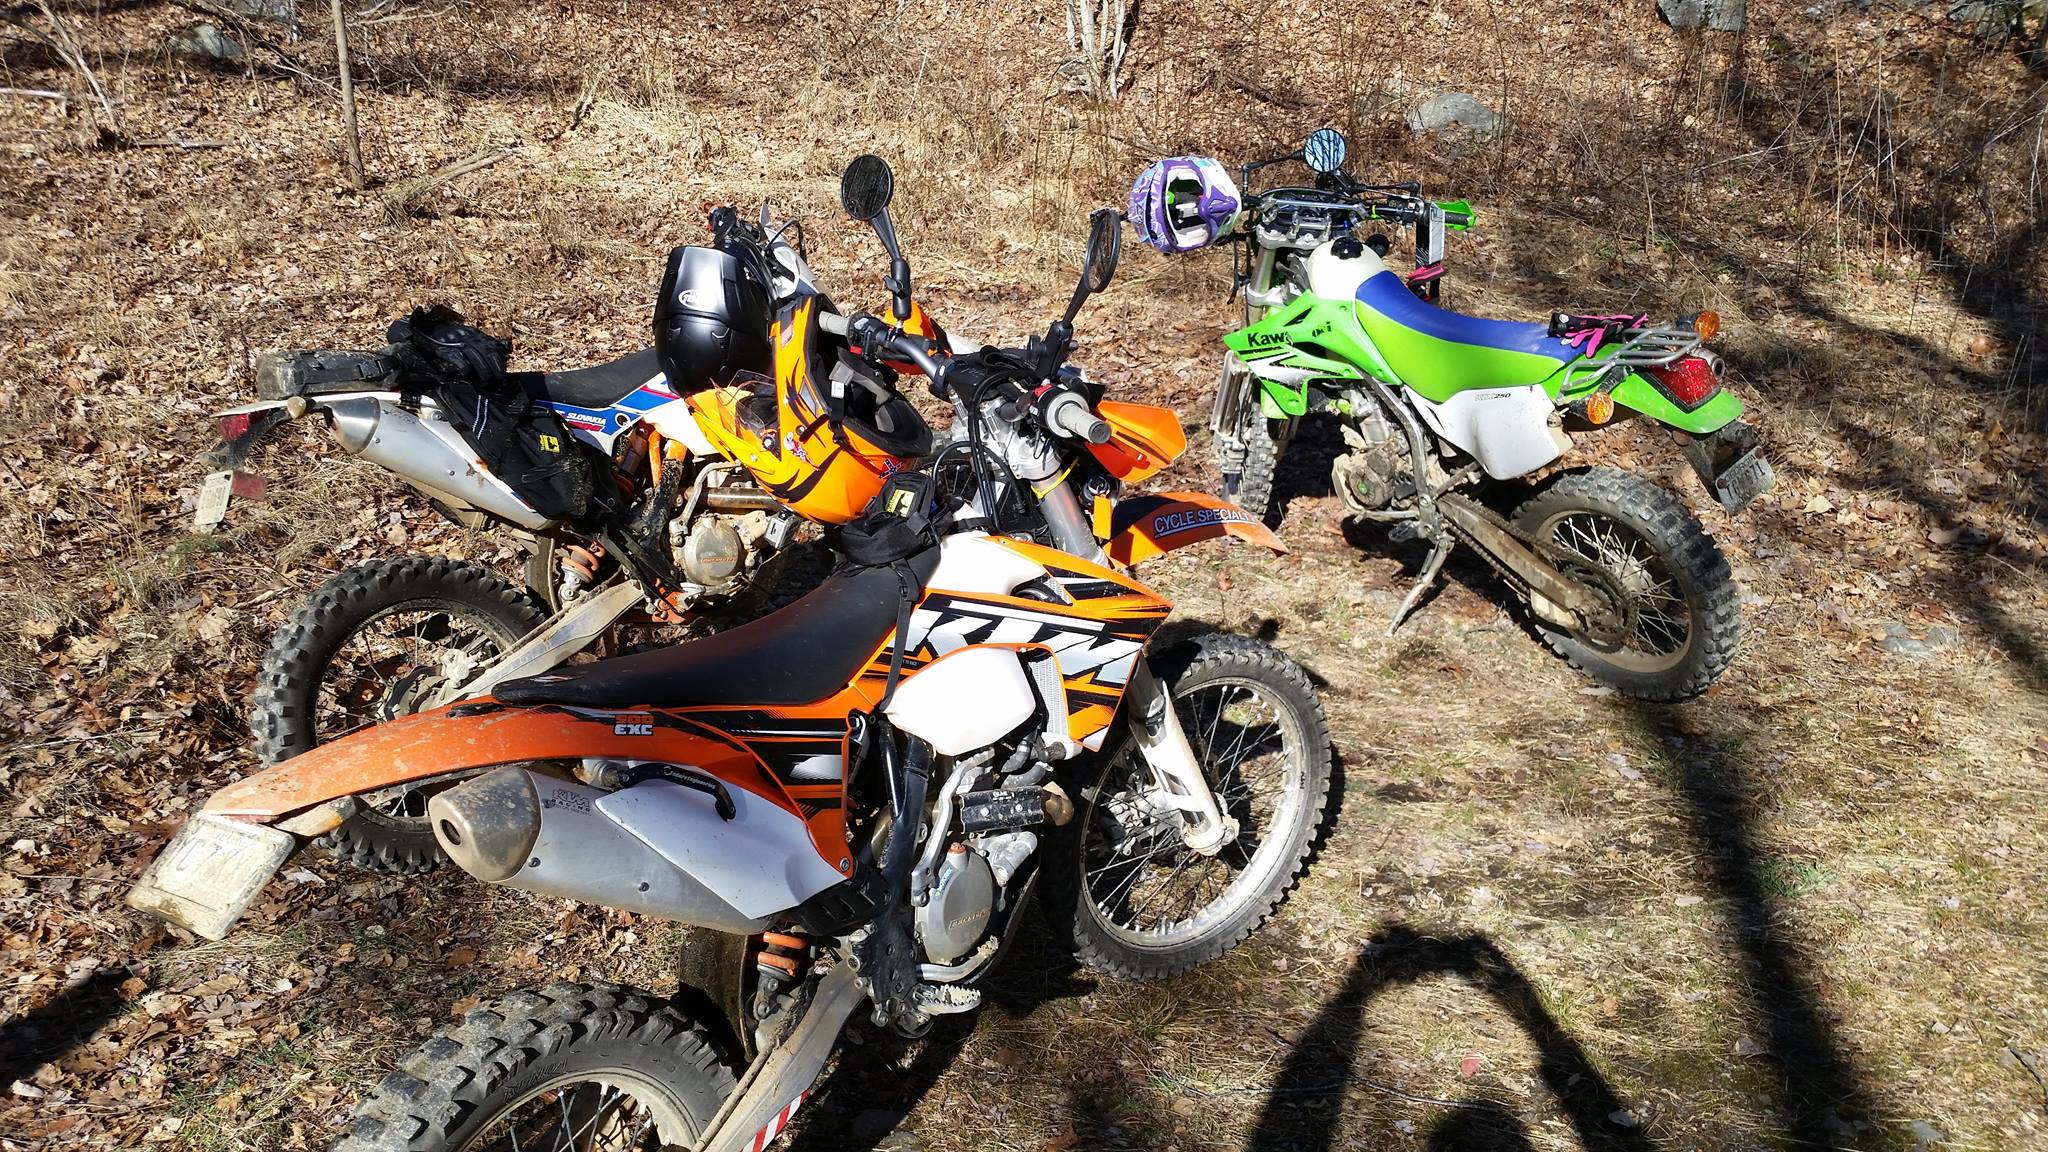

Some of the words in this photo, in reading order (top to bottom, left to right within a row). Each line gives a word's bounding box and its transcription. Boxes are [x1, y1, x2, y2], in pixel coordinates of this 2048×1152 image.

[1154, 511, 1195, 533] CYCLE
[887, 607, 1145, 685] KTM
[614, 714, 655, 725] 500
[614, 724, 654, 735] EXC
